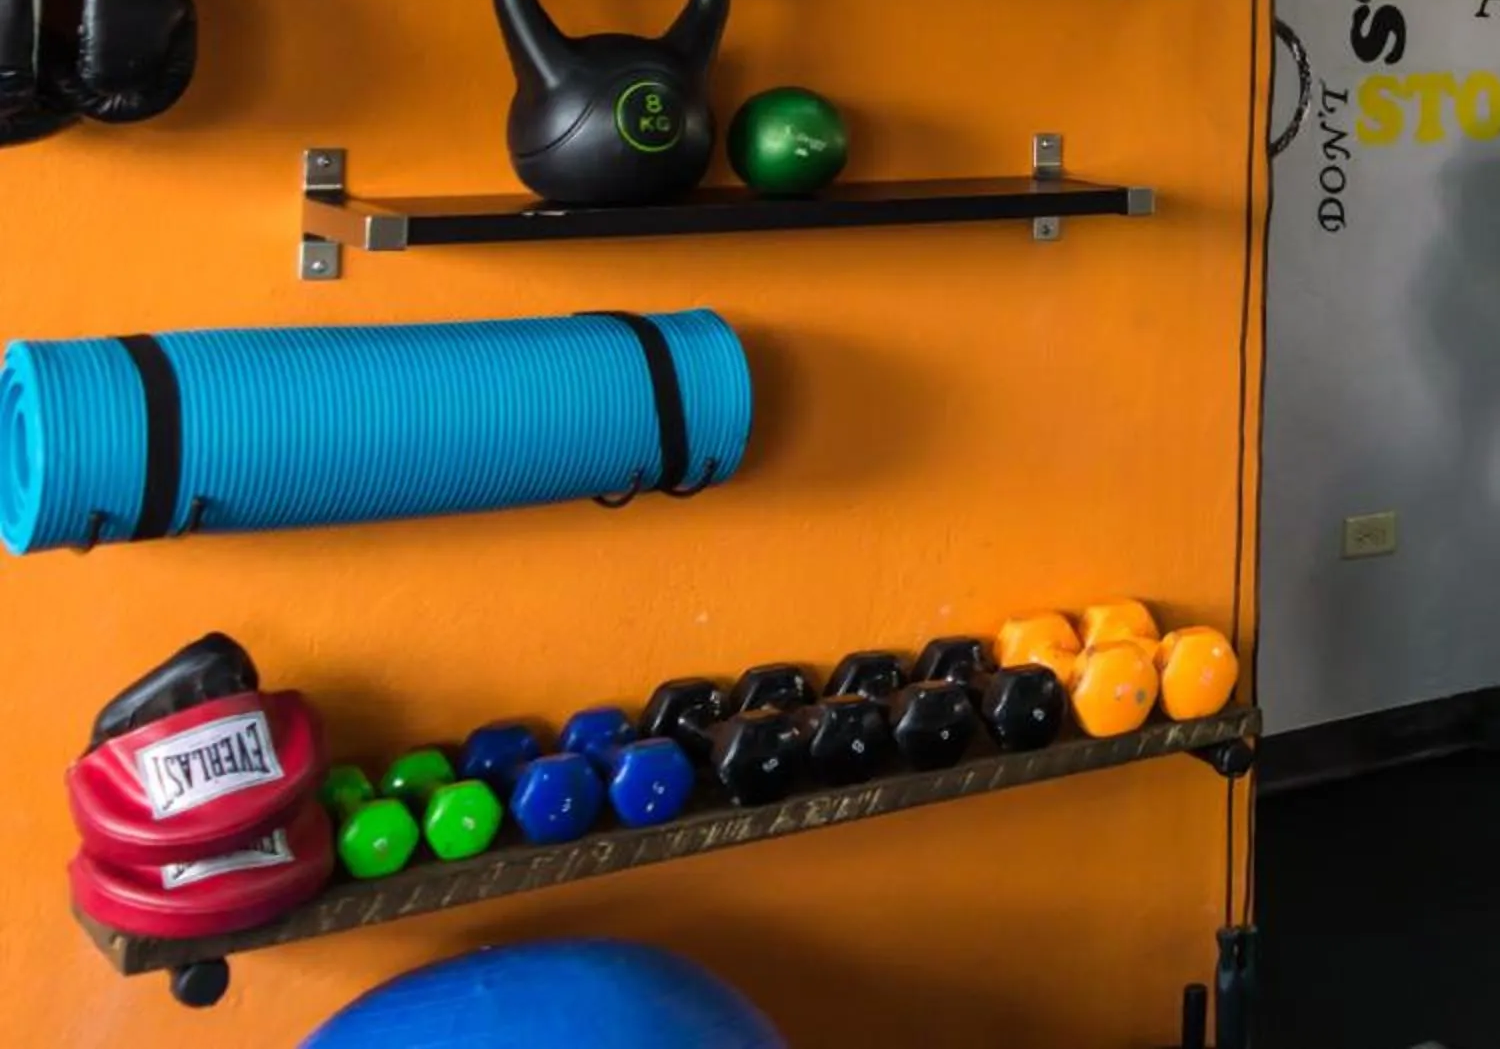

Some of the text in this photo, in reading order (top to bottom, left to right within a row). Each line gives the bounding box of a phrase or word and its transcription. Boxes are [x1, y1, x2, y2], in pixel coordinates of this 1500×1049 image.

[645, 94, 663, 114] 8
[1317, 79, 1351, 233] DON'T
[153, 720, 272, 811] EVERLAST
